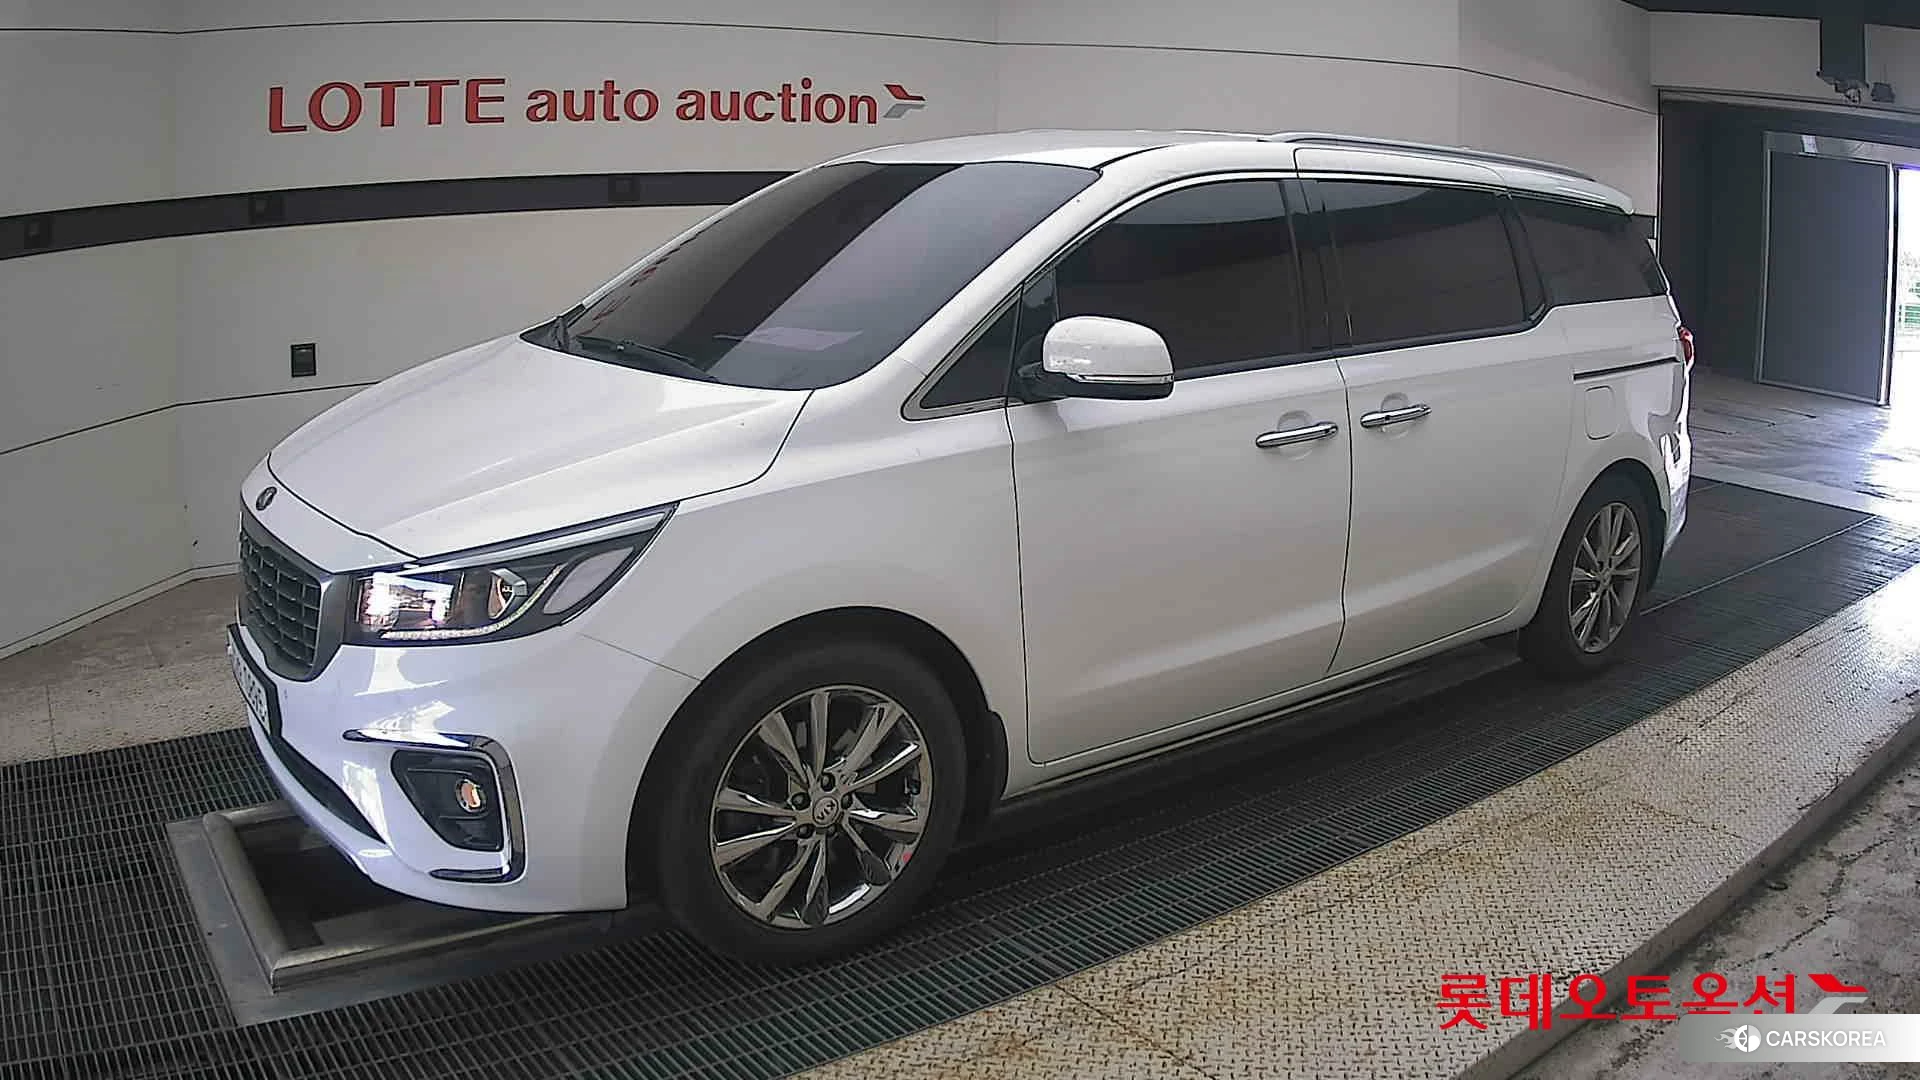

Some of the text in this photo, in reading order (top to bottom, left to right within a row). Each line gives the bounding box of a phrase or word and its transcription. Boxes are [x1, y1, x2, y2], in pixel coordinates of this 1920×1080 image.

[269, 78, 879, 133] LOTTE auto auction
